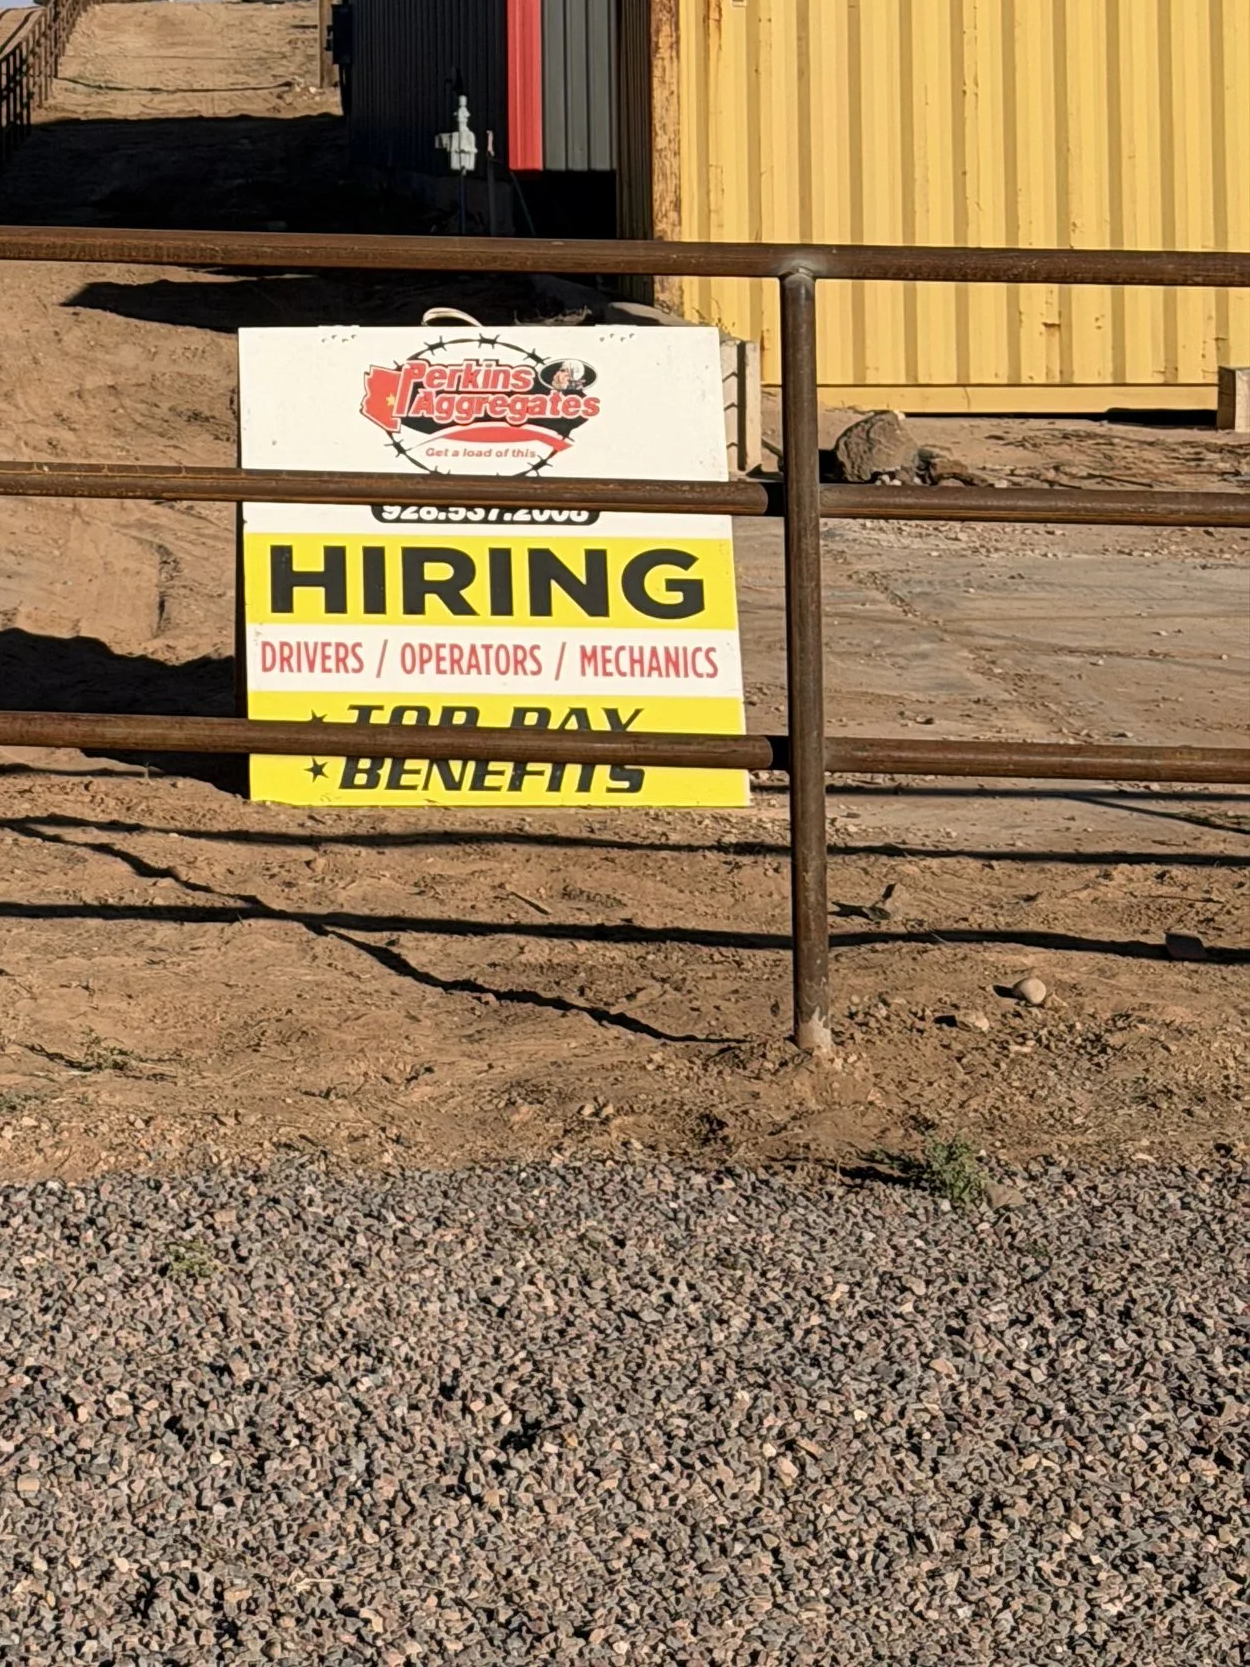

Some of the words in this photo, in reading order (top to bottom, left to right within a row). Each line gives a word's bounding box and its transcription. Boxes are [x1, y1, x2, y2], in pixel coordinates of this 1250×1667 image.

[394, 360, 534, 414] Perkins
[410, 390, 601, 423] Aggregates
[425, 447, 449, 457] Get
[452, 449, 460, 457] a
[463, 448, 492, 458] load
[495, 448, 509, 458] of
[512, 448, 536, 458] this
[269, 544, 706, 620] HIRING
[260, 640, 364, 675] DRIVERS
[400, 642, 543, 677] OPERATORS
[580, 644, 719, 679] MECHANICS
[338, 756, 645, 794] BENEFITS
